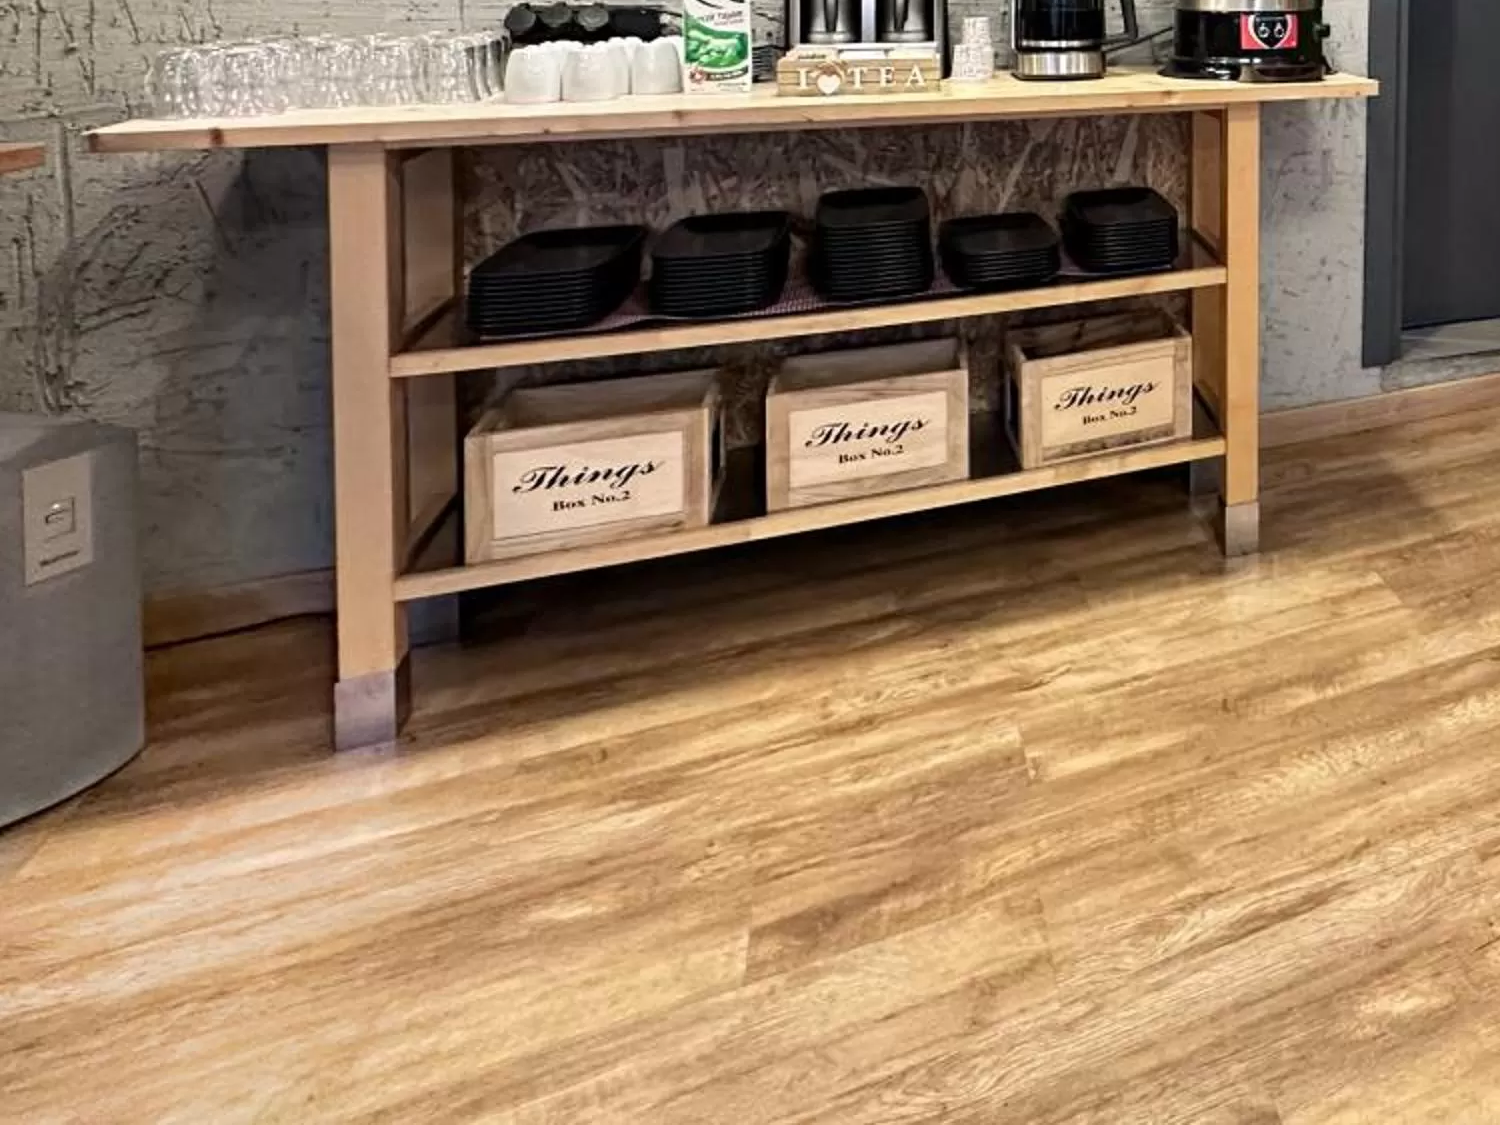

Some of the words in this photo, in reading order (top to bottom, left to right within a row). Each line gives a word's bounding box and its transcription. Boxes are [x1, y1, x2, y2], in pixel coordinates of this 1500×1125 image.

[1054, 382, 1161, 410] Things
[805, 418, 930, 448] Things
[839, 453, 866, 464] Box
[871, 444, 904, 458] No.2
[512, 460, 665, 493] Things
[553, 499, 586, 512] Box
[592, 490, 631, 506] No.2
